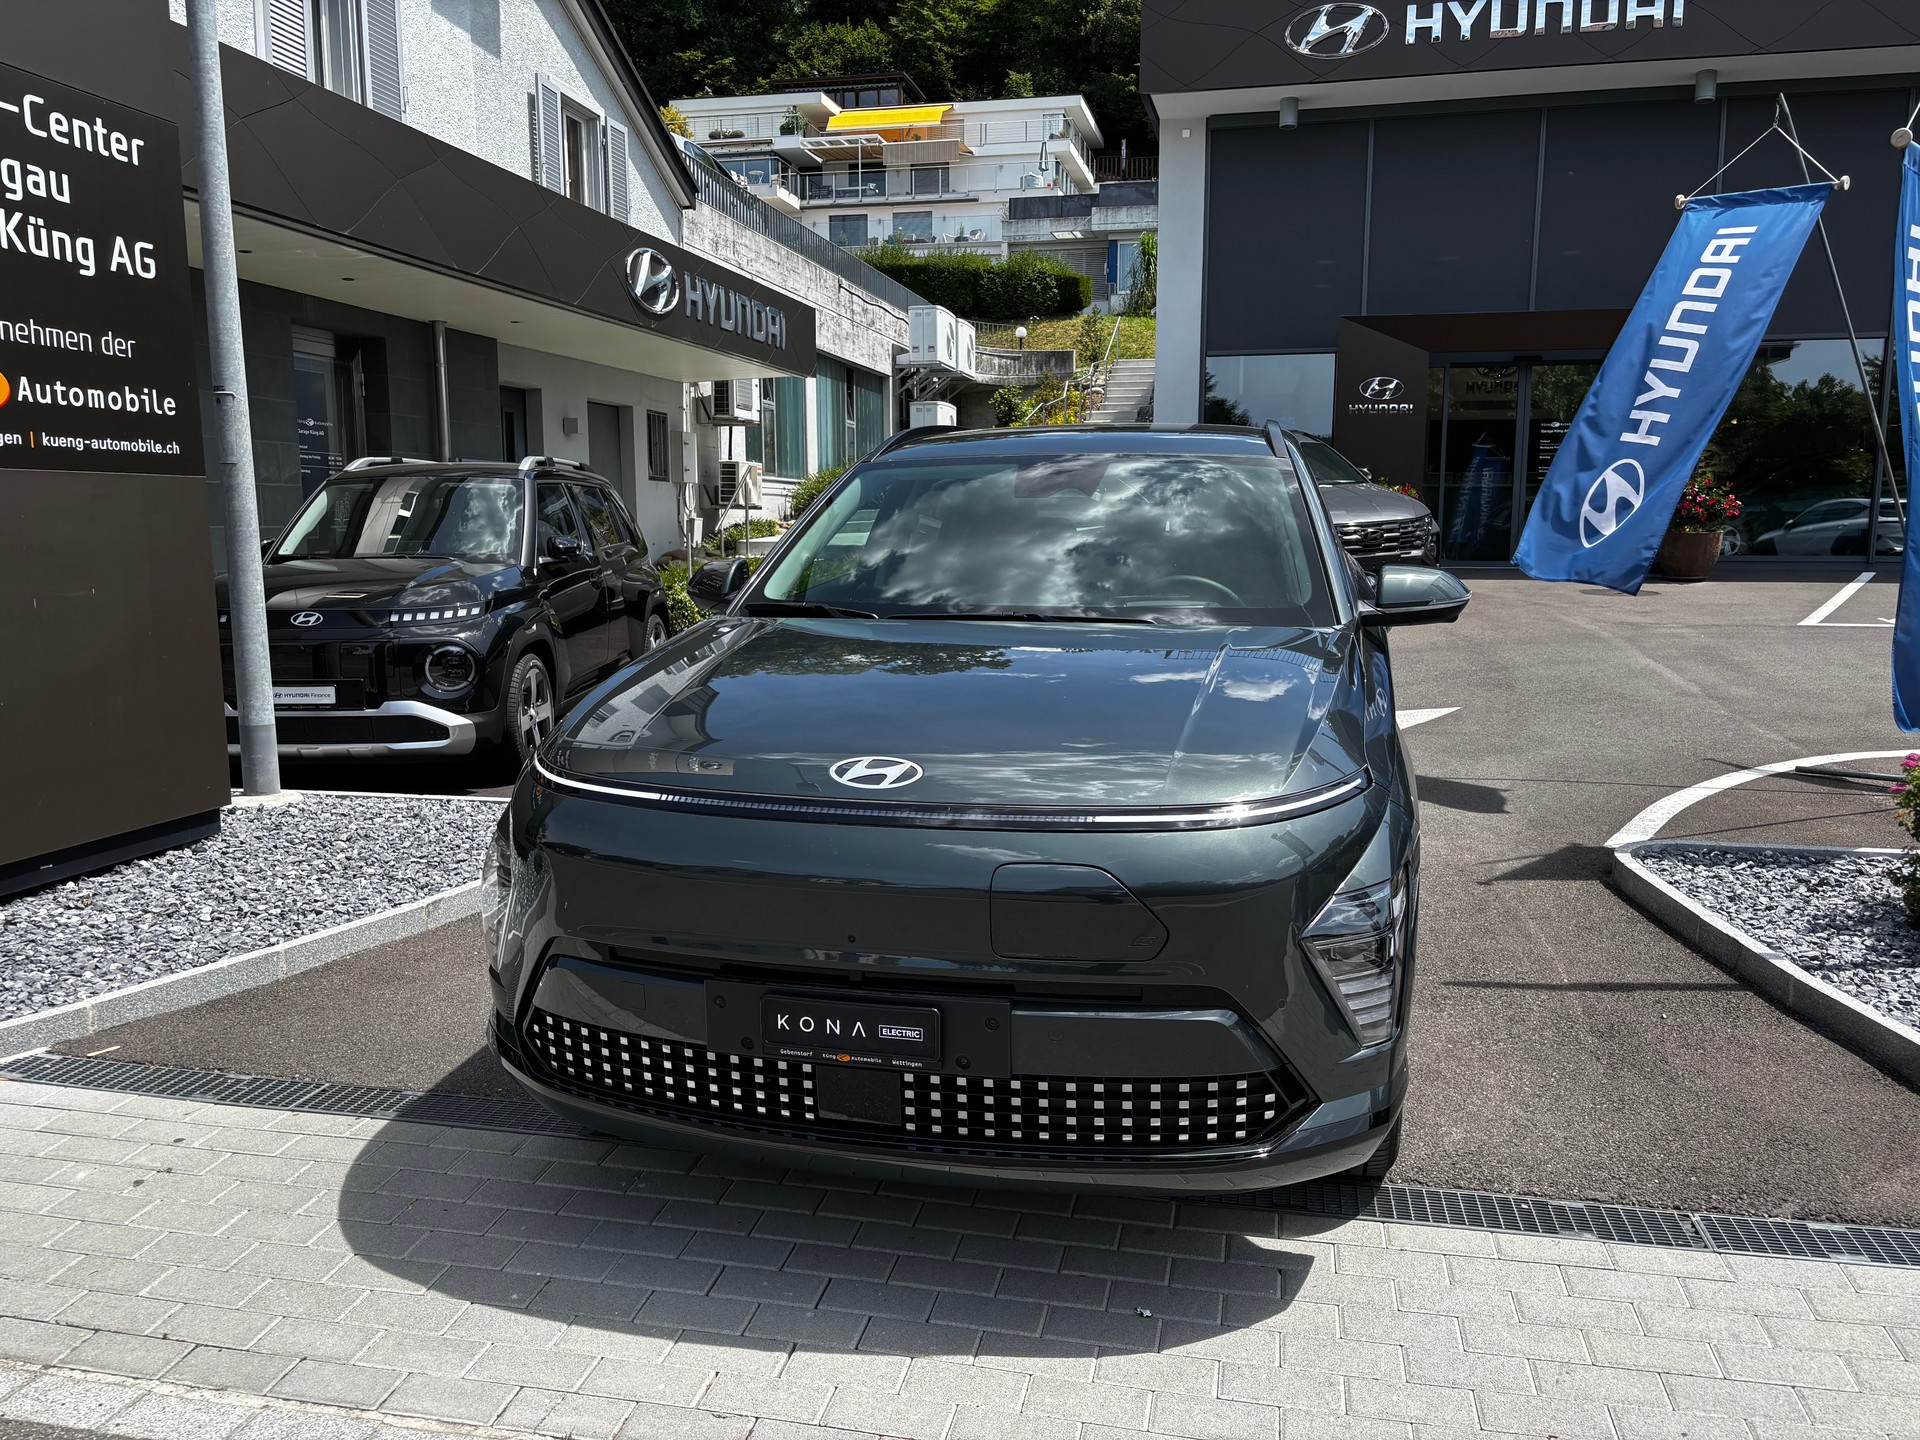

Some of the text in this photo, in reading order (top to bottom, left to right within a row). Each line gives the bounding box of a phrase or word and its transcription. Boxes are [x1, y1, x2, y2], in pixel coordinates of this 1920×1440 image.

[1405, 0, 1684, 44] HYUNDAI
[0, 157, 71, 204] gau
[110, 235, 157, 279] AG
[683, 271, 786, 350] HYUNDAI
[101, 331, 136, 358] der
[1619, 225, 1758, 447] HYUNDAI
[17, 375, 177, 416] Automobile
[1348, 403, 1414, 415] HYUNDAI
[42, 432, 180, 454] kueng-automobile.ch
[881, 1028, 921, 1039] ELECTRIC
[780, 1048, 813, 1057] Gebenstorf
[851, 1056, 882, 1064] Automobile
[892, 1059, 923, 1068] Wettingen
